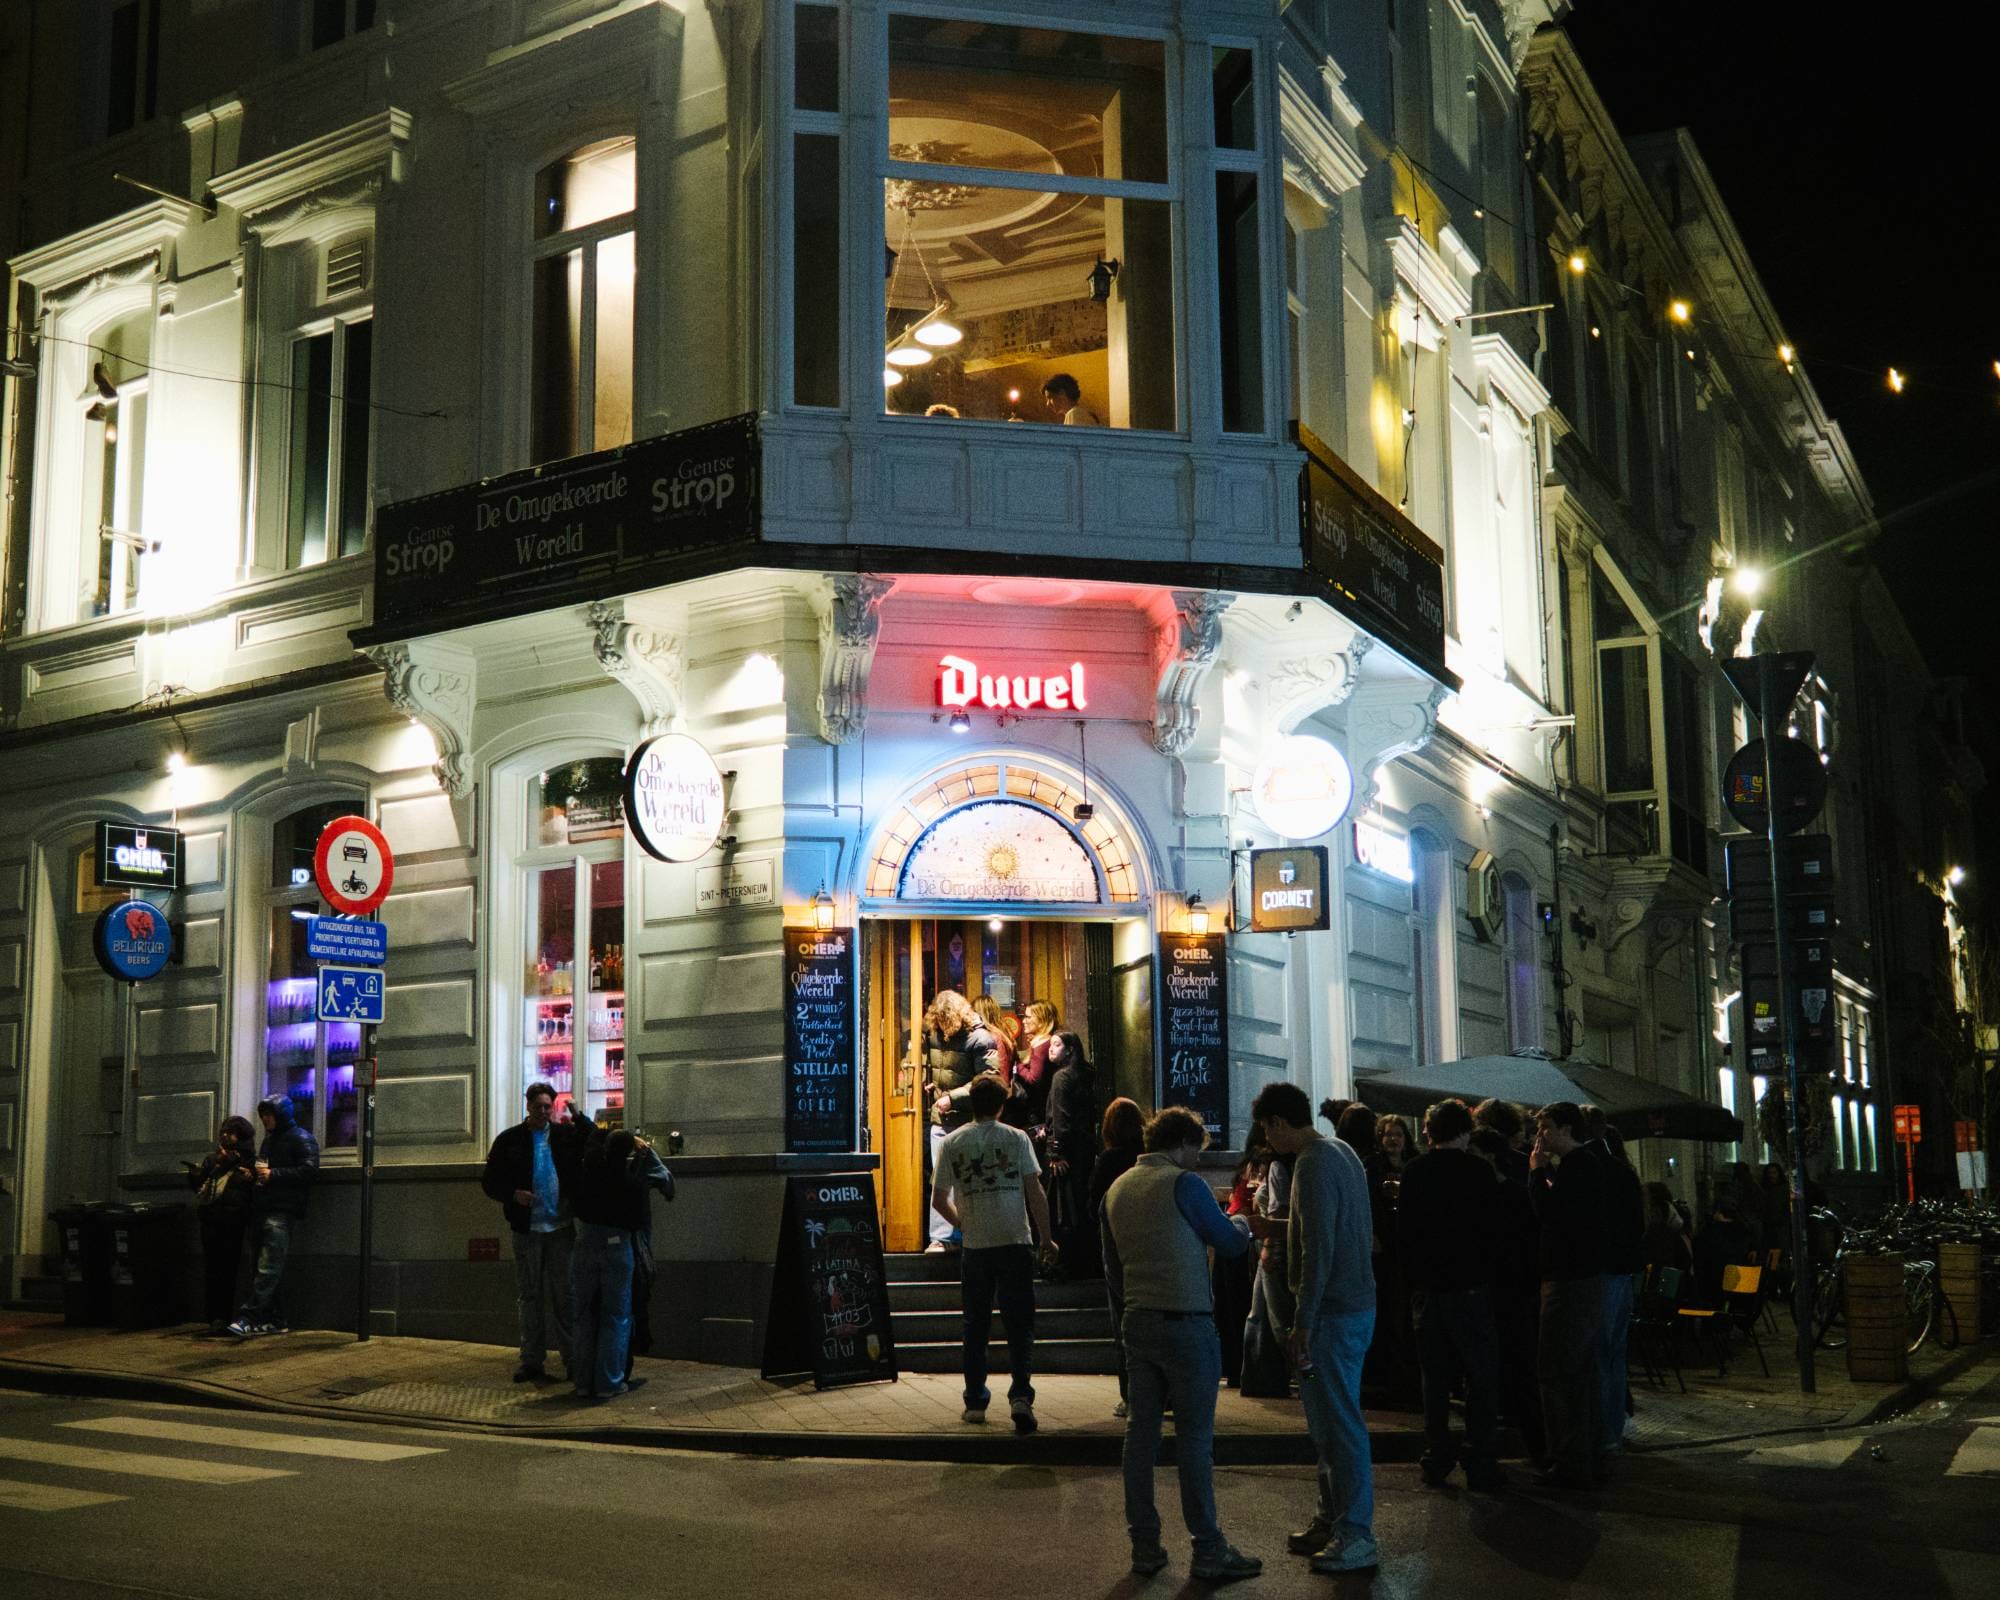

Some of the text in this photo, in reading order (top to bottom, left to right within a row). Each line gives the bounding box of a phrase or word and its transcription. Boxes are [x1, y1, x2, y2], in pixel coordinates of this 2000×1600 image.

[678, 455, 736, 480] Gentse
[475, 470, 630, 532] De Omgekeerde
[652, 473, 736, 514] Strop
[408, 523, 456, 546] Gentse
[1315, 500, 1348, 560] Strop
[514, 523, 583, 566] Wereld
[386, 540, 455, 576] Strop
[1416, 583, 1442, 633] Strop
[937, 654, 1088, 711] Duvel
[650, 753, 666, 774] De
[1261, 888, 1314, 911] CORNET
[373, 939, 380, 947] EN
[127, 955, 151, 965] BEERS
[1173, 965, 1185, 976] De
[794, 983, 834, 997] Wereld
[1169, 985, 1209, 1000] Wereld
[792, 1062, 842, 1076] STELLA
[1170, 1049, 1211, 1074] Live
